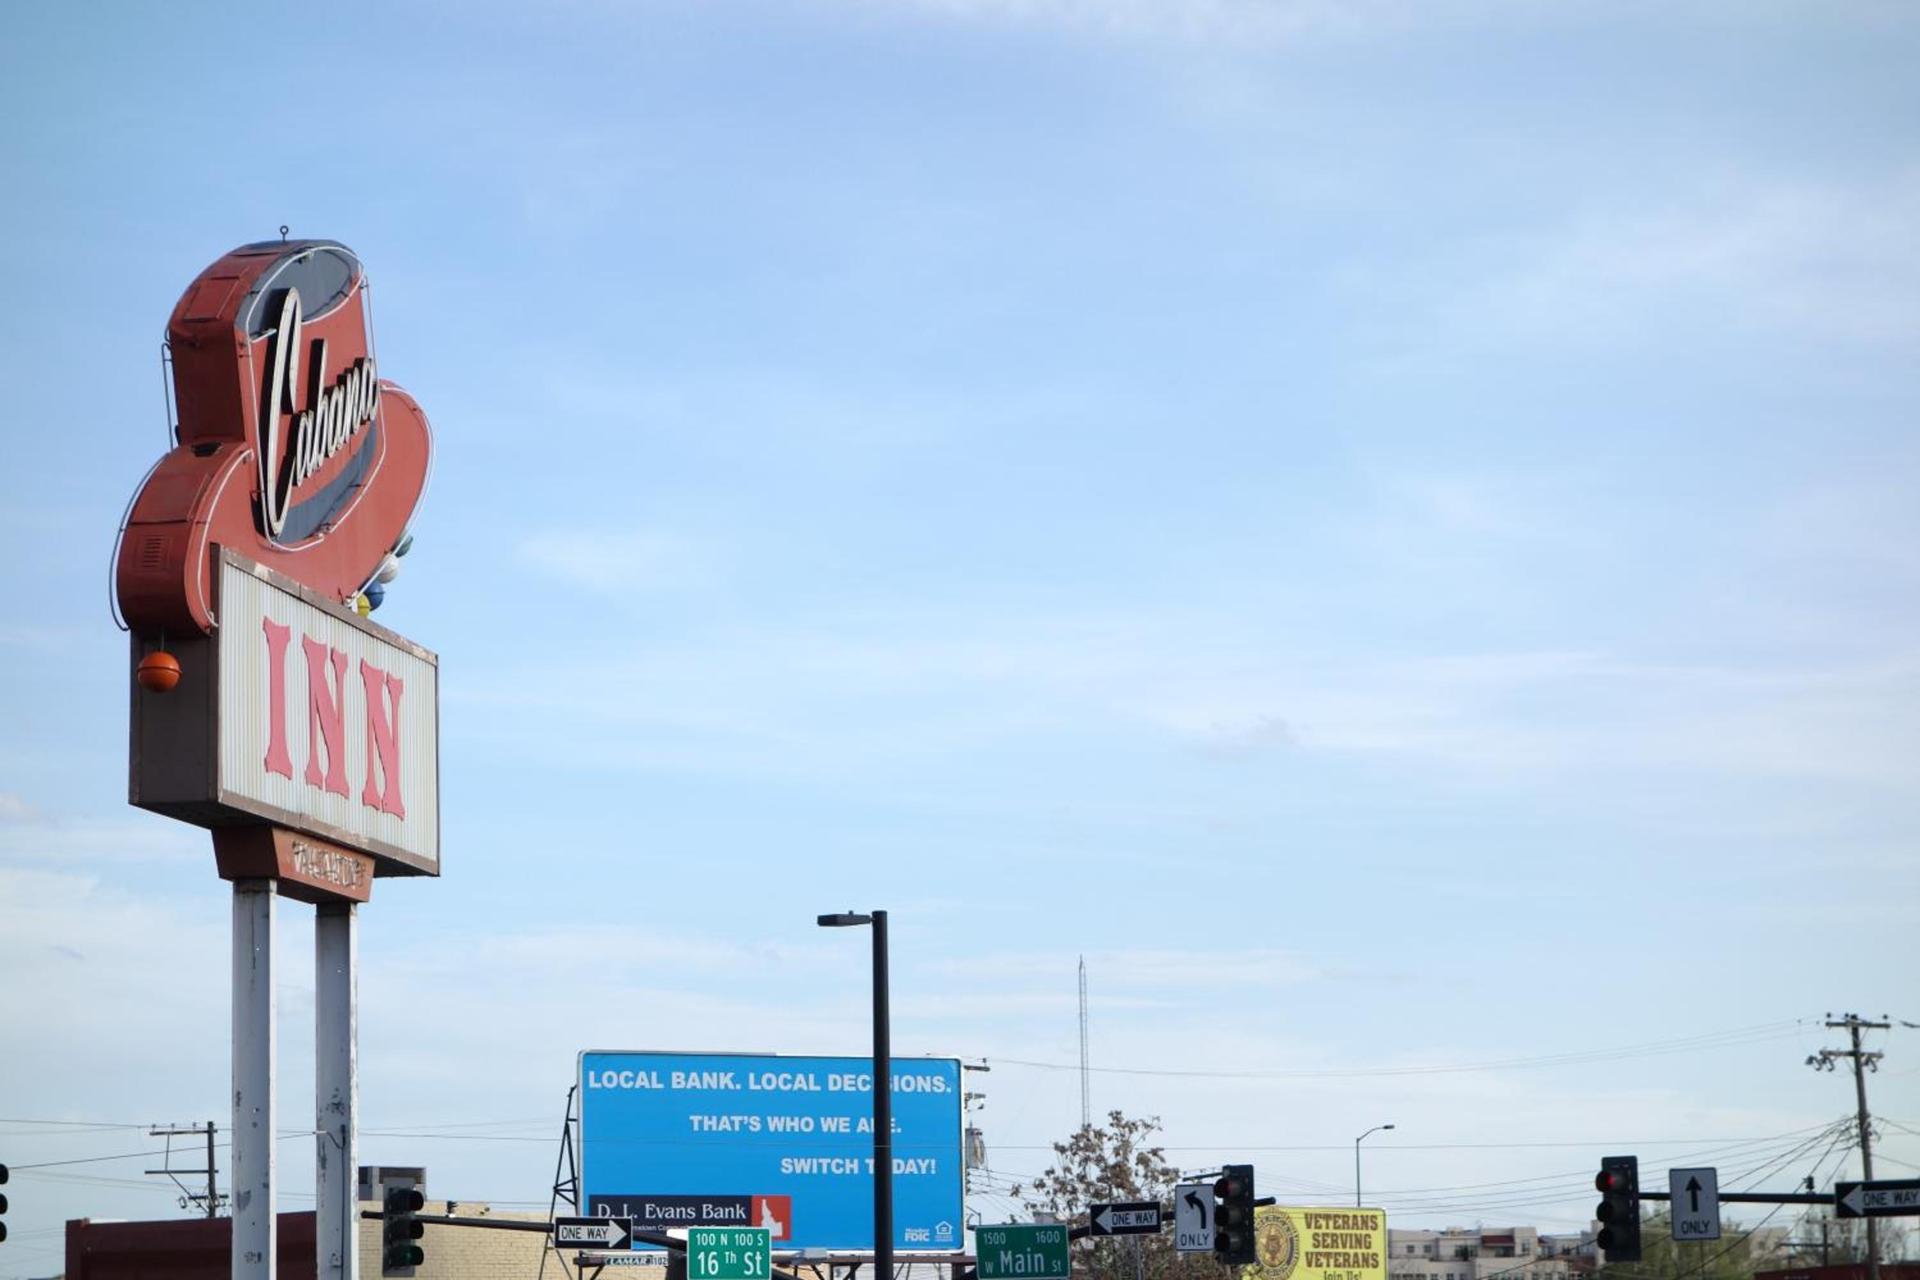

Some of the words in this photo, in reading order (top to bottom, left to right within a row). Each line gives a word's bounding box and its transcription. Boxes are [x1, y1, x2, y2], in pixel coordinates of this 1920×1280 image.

[266, 287, 379, 536] Cabana
[263, 616, 406, 820] INN
[589, 1070, 663, 1088] LOCAL
[671, 1072, 741, 1090] BANK.
[748, 1072, 820, 1092] LOCAL
[828, 1074, 952, 1093] DECIONS.
[690, 1116, 761, 1132] THAT'S
[767, 1116, 814, 1133] WHO
[820, 1116, 850, 1133] WE
[855, 1116, 902, 1134] AE.
[780, 1158, 859, 1174] SWITCH
[864, 1158, 937, 1175] TDAY!
[1863, 1193, 1887, 1205] ONE
[1894, 1192, 1919, 1204] WAY
[598, 1203, 615, 1218] D.
[623, 1203, 638, 1218] L.
[645, 1204, 696, 1219] Evans
[702, 1203, 746, 1219] Bank
[1111, 1212, 1131, 1226] ONE
[1135, 1211, 1155, 1224] WAY
[1305, 1213, 1378, 1230] VETERANS
[1681, 1221, 1711, 1234] ONLY
[562, 1227, 584, 1239] ONE
[587, 1227, 609, 1239] WAY
[696, 1233, 715, 1245] 100
[720, 1234, 727, 1245] N
[735, 1234, 752, 1245] 100
[757, 1234, 763, 1245] S
[905, 1233, 930, 1241] FDIC
[984, 1232, 1006, 1244] 1500
[1036, 1231, 1060, 1243] 1600
[1180, 1233, 1210, 1246] ONLY
[1312, 1233, 1372, 1249] SERVING
[698, 1252, 718, 1275] 16
[725, 1252, 736, 1264] Th
[744, 1251, 762, 1275] St
[985, 1262, 994, 1274] W
[1000, 1248, 1044, 1273] Main
[1052, 1260, 1062, 1272] St
[1306, 1252, 1379, 1268] VETERANS
[1324, 1271, 1345, 1280] Join
